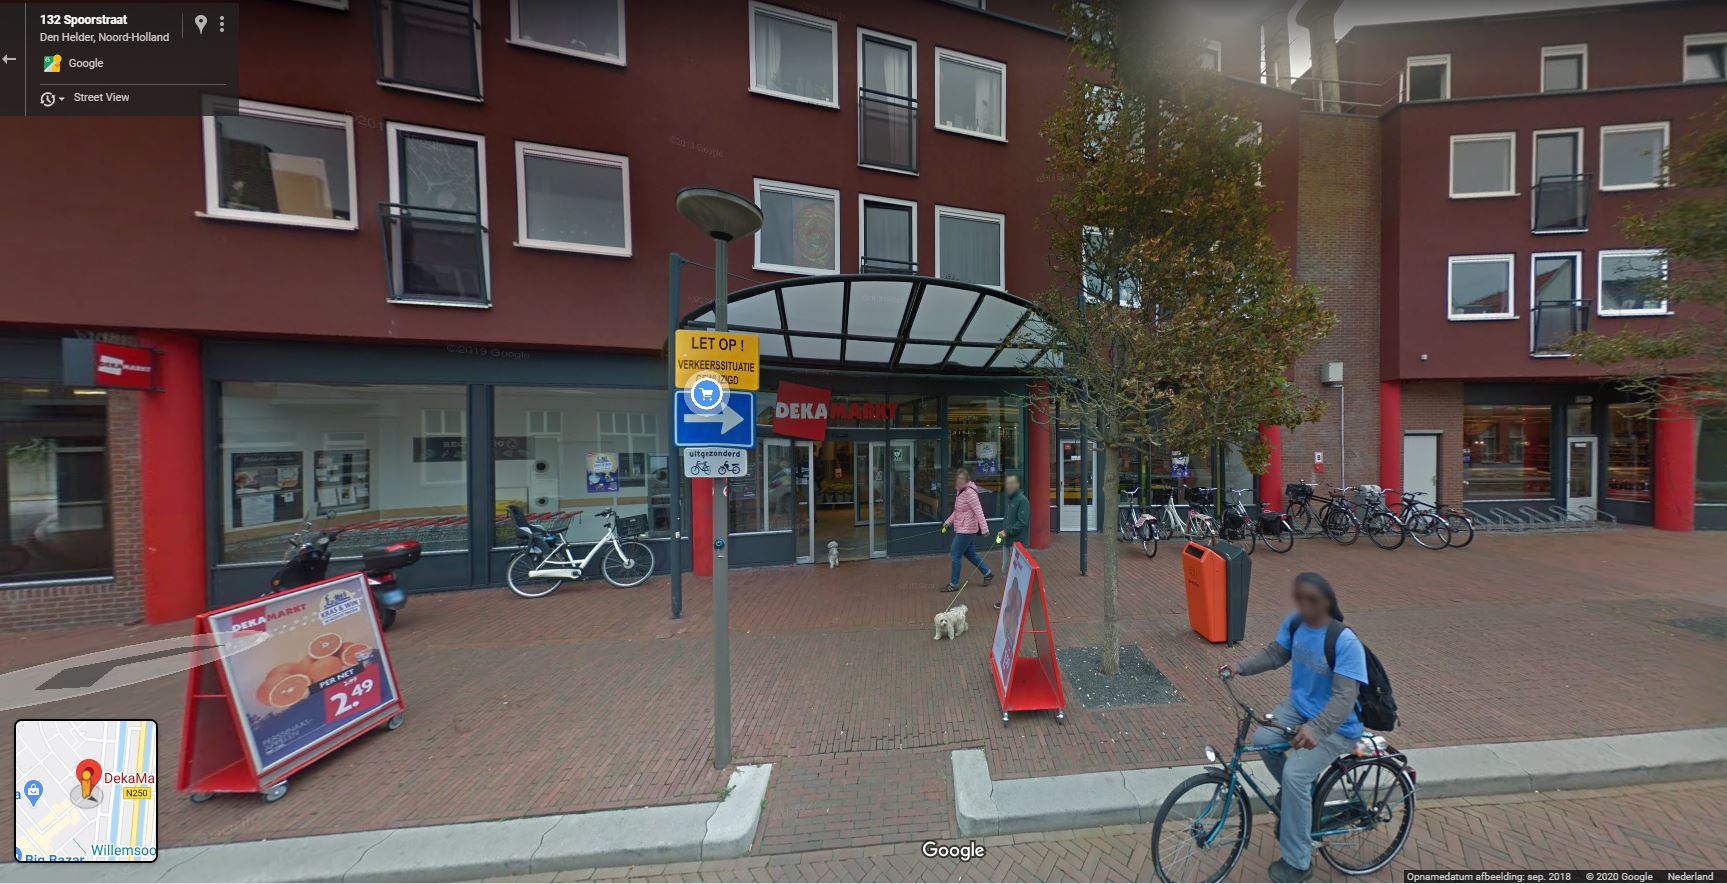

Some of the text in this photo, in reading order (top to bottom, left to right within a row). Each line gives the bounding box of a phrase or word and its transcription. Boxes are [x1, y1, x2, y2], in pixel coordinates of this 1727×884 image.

[692, 336, 715, 350] LET
[718, 338, 737, 351] OP
[678, 359, 755, 373] VERKEERSSITUATIE
[689, 450, 741, 460] uitgezonderd
[320, 668, 354, 689] PER NET
[330, 678, 374, 717] 2.49
